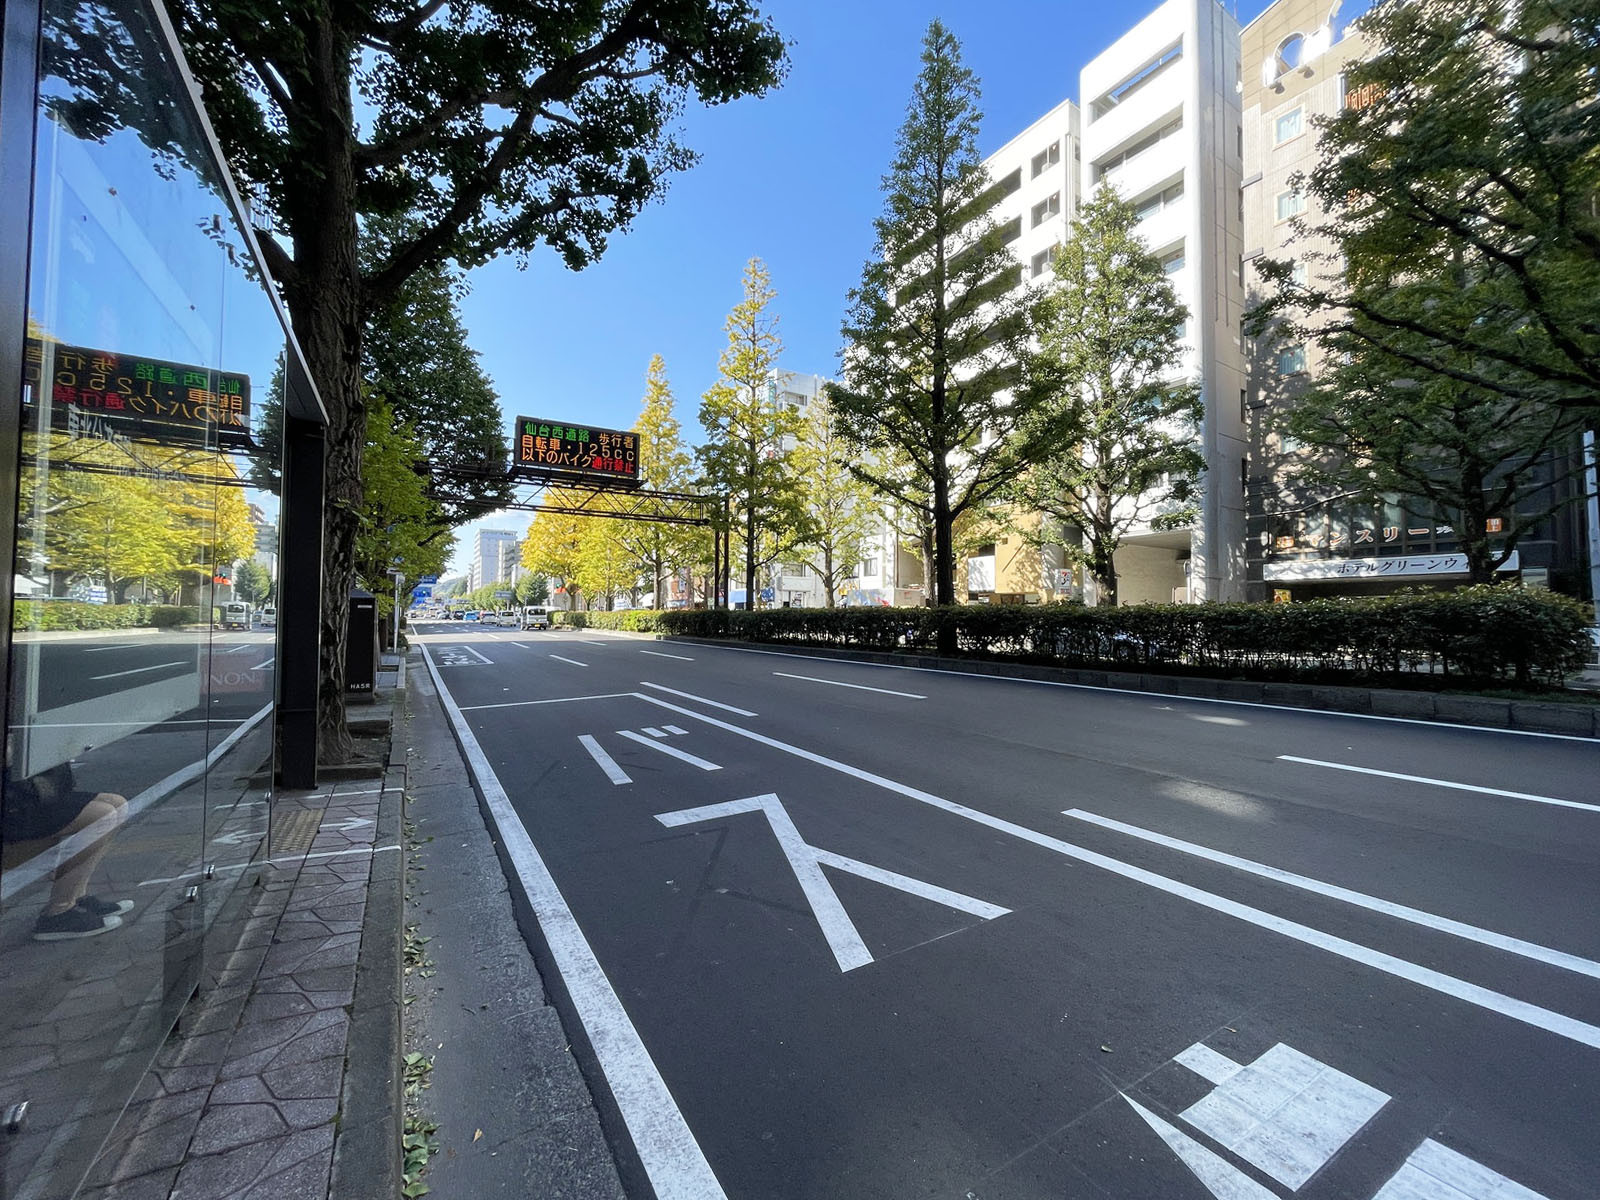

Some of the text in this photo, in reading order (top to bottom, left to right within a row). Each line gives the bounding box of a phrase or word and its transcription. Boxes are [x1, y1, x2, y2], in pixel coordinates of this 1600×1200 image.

[524, 421, 635, 450] 仙台西道路 歩行者
